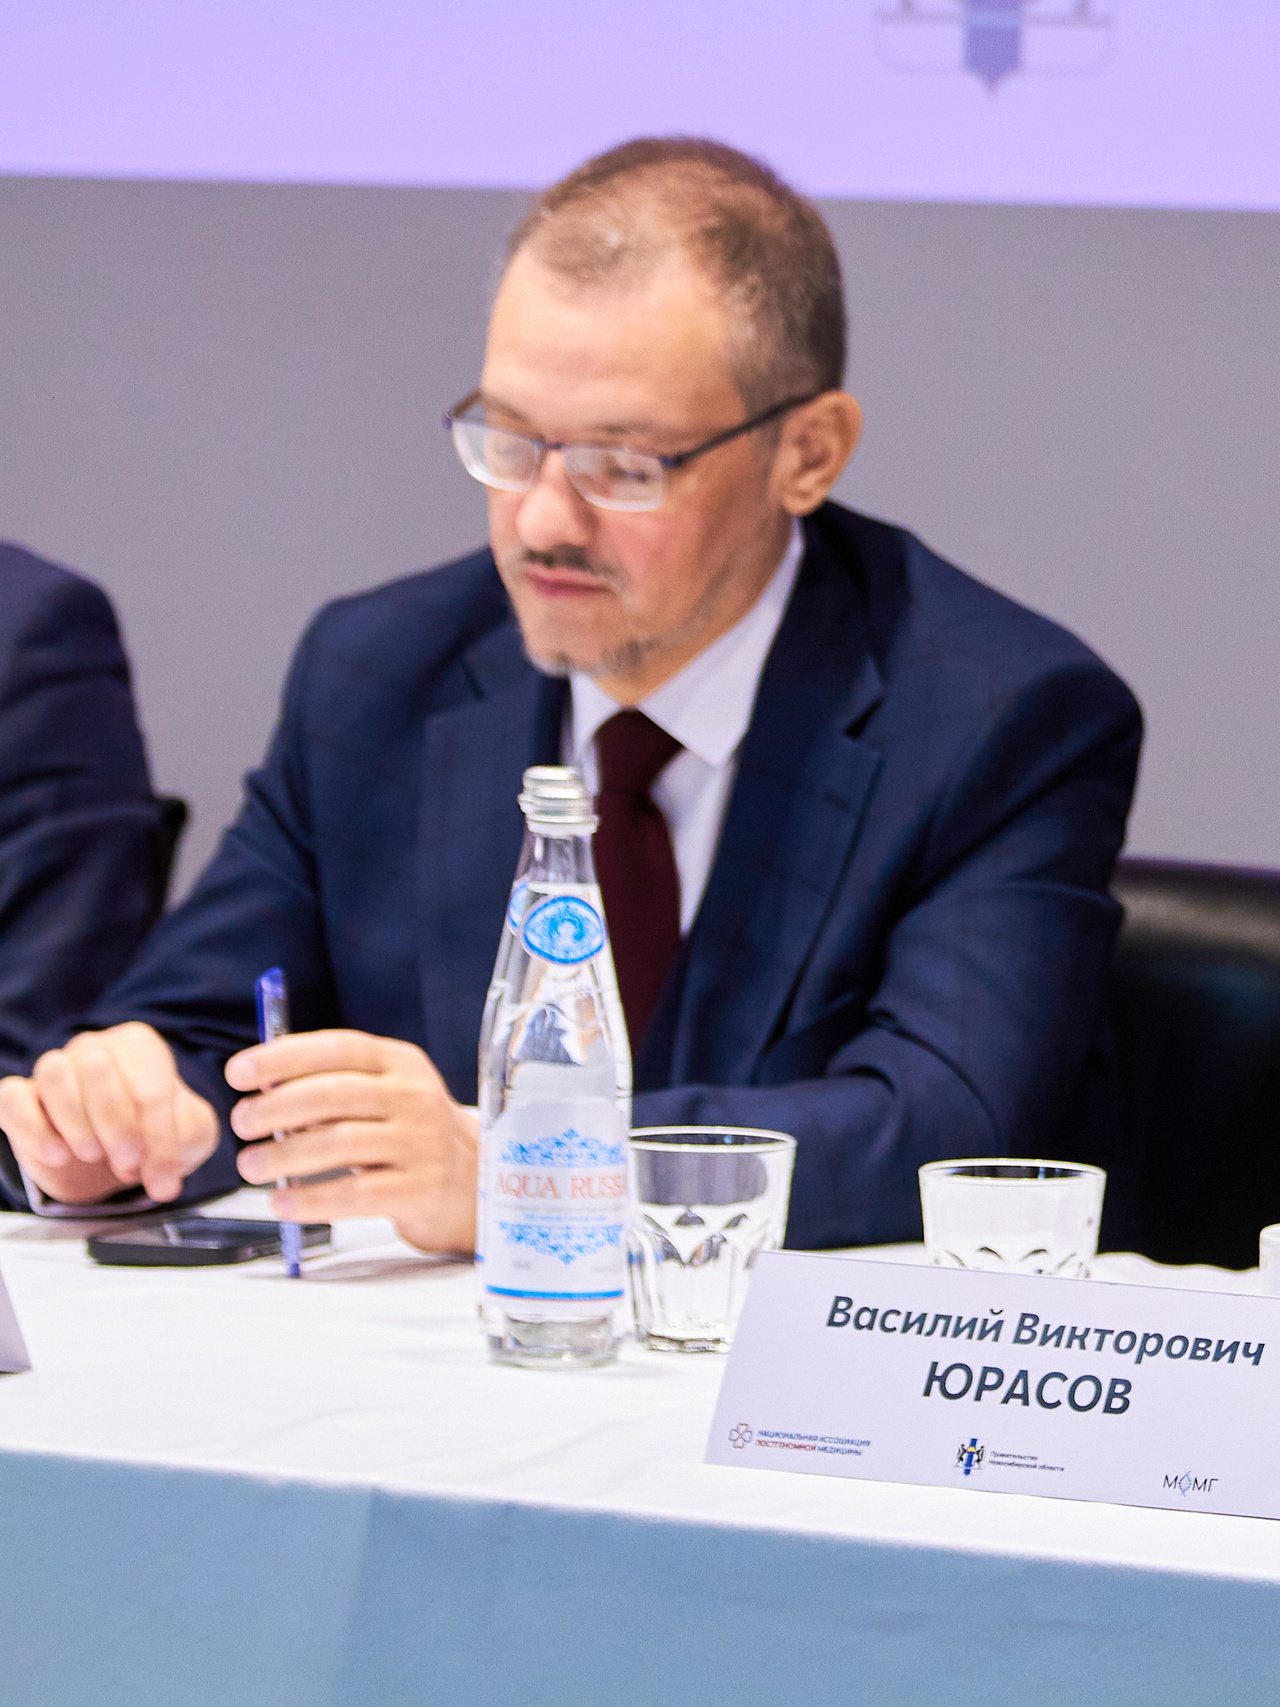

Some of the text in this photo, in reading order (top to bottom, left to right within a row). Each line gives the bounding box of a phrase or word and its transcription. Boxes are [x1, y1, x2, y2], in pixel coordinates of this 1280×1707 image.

[496, 1172, 560, 1198] AQUA
[826, 1295, 1266, 1367] Василий Викторович
[922, 1361, 1133, 1415] ЮРАСОВ
